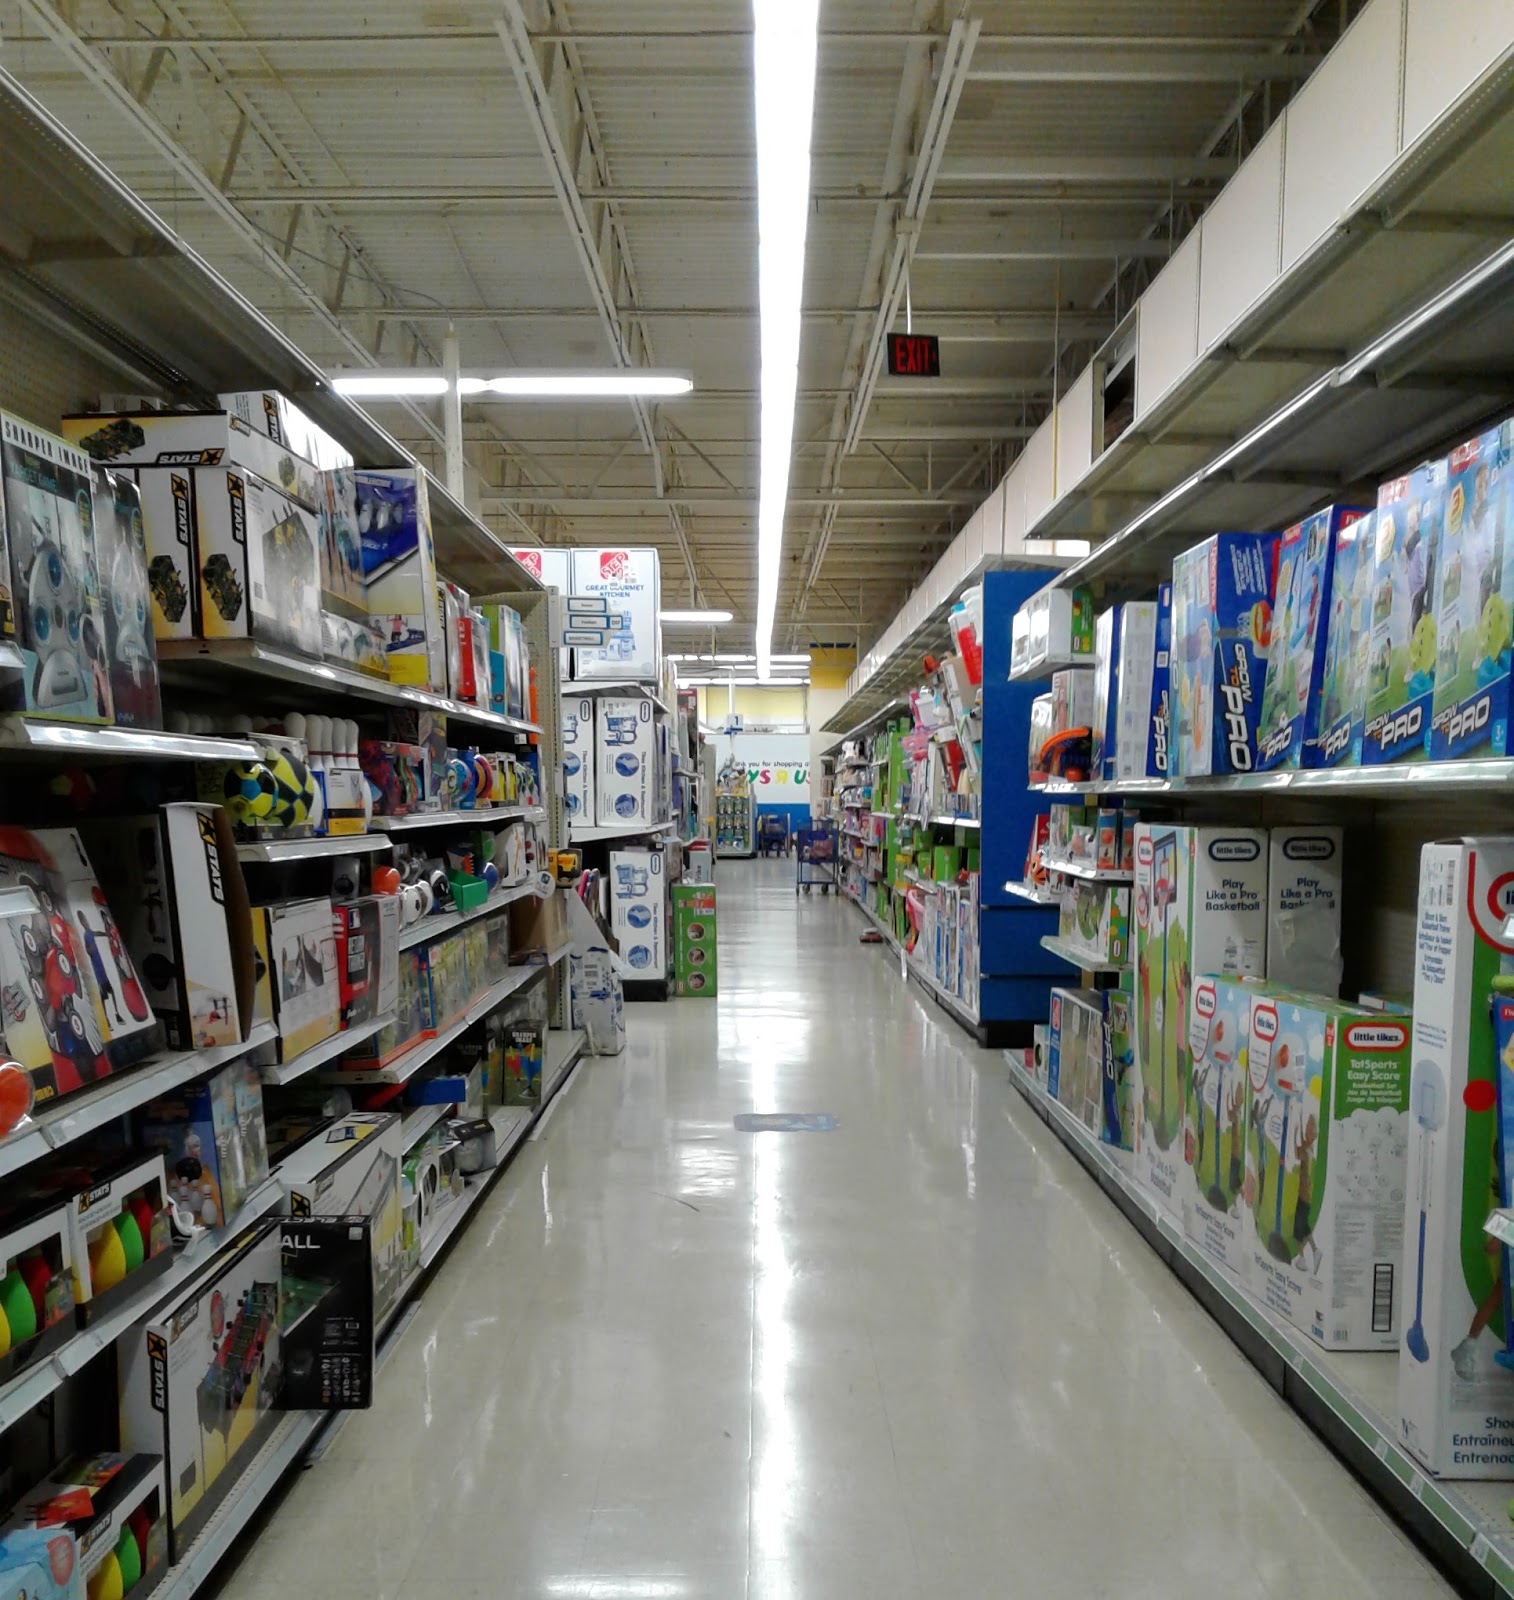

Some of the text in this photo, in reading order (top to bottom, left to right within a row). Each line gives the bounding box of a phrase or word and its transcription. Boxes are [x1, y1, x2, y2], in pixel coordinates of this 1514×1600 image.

[895, 336, 930, 373] EXIT
[5, 421, 89, 474] SHARPER IMAGE
[159, 454, 201, 463] STATS
[177, 498, 188, 544] STATS
[233, 497, 244, 542] STATS
[602, 553, 625, 575] STEP
[1221, 684, 1252, 771] PRO
[1448, 696, 1490, 745] PRO
[1381, 706, 1422, 751] PRO
[774, 760, 803, 768] shopping
[747, 769, 771, 785] YS
[1216, 846, 1252, 854] little tikes
[207, 845, 225, 901] STATS
[1222, 878, 1244, 890] Play
[1297, 878, 1319, 889] Play
[1206, 890, 1226, 899] Like
[1240, 890, 1257, 899] Pro
[1281, 889, 1301, 898] Like
[1315, 889, 1333, 898] Pro
[1205, 901, 1260, 911] Basketball
[1354, 1031, 1399, 1041] little tikes
[1350, 1059, 1398, 1070] TotSports
[1347, 1070, 1400, 1083] Easy Score
[90, 1185, 110, 1201] STATS
[281, 1234, 321, 1249] ALL
[154, 1359, 165, 1409] STATS
[1485, 1416, 1514, 1429] Shoo
[1452, 1433, 1514, 1446] Entraîneu
